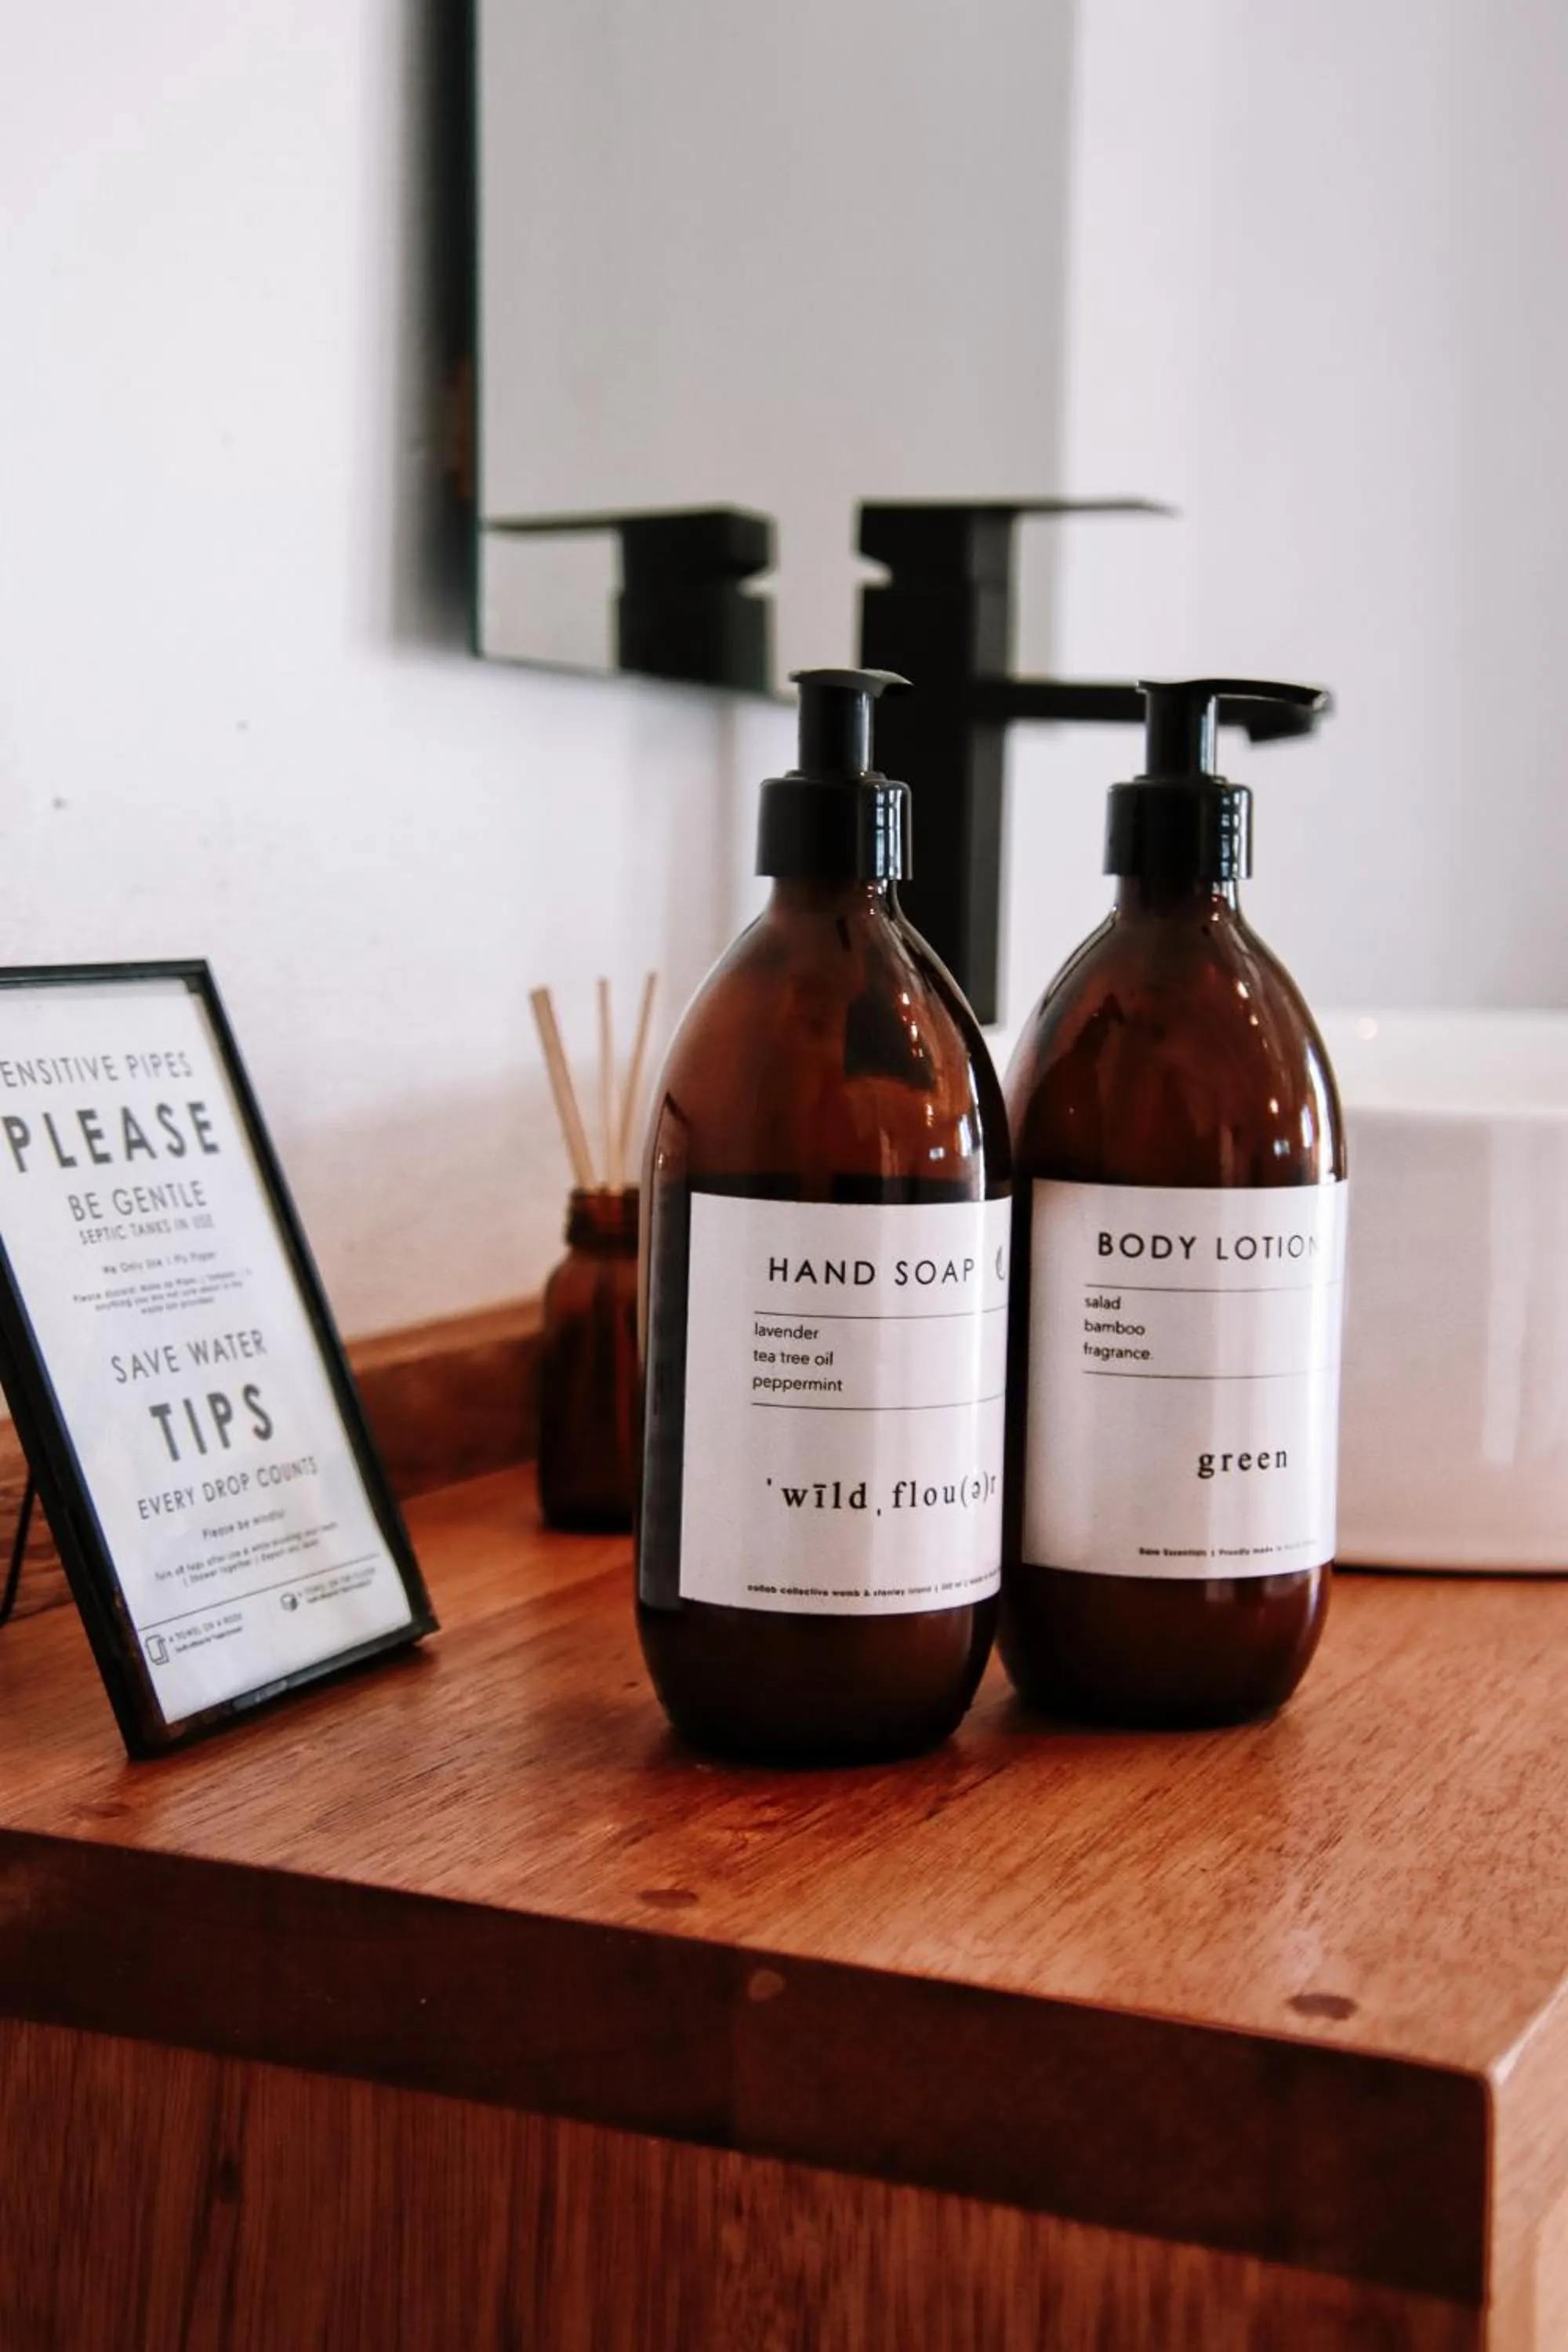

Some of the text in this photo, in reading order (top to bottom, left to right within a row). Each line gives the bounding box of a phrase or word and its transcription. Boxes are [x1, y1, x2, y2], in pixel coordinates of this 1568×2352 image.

[0, 1051, 193, 1087] ENSITIVE PIPES
[2, 1101, 220, 1173] PLEASE
[67, 1180, 207, 1222] BE GENTLE
[79, 1225, 127, 1246] SEPTIC
[129, 1218, 172, 1237] TANKS
[1098, 1232, 1196, 1260] BODY
[768, 1257, 975, 1286] HAND SOAP
[1084, 1296, 1120, 1310] salad
[754, 1322, 819, 1340] lavender
[1084, 1319, 1145, 1335] bamboo
[111, 1330, 267, 1384] SAVE WATER
[753, 1349, 834, 1366] tea tree oil
[753, 1376, 843, 1392] peppermint
[149, 1383, 274, 1463] TIPS
[1197, 1449, 1288, 1479] green
[137, 1456, 318, 1520] EVERY DROP COUNTS
